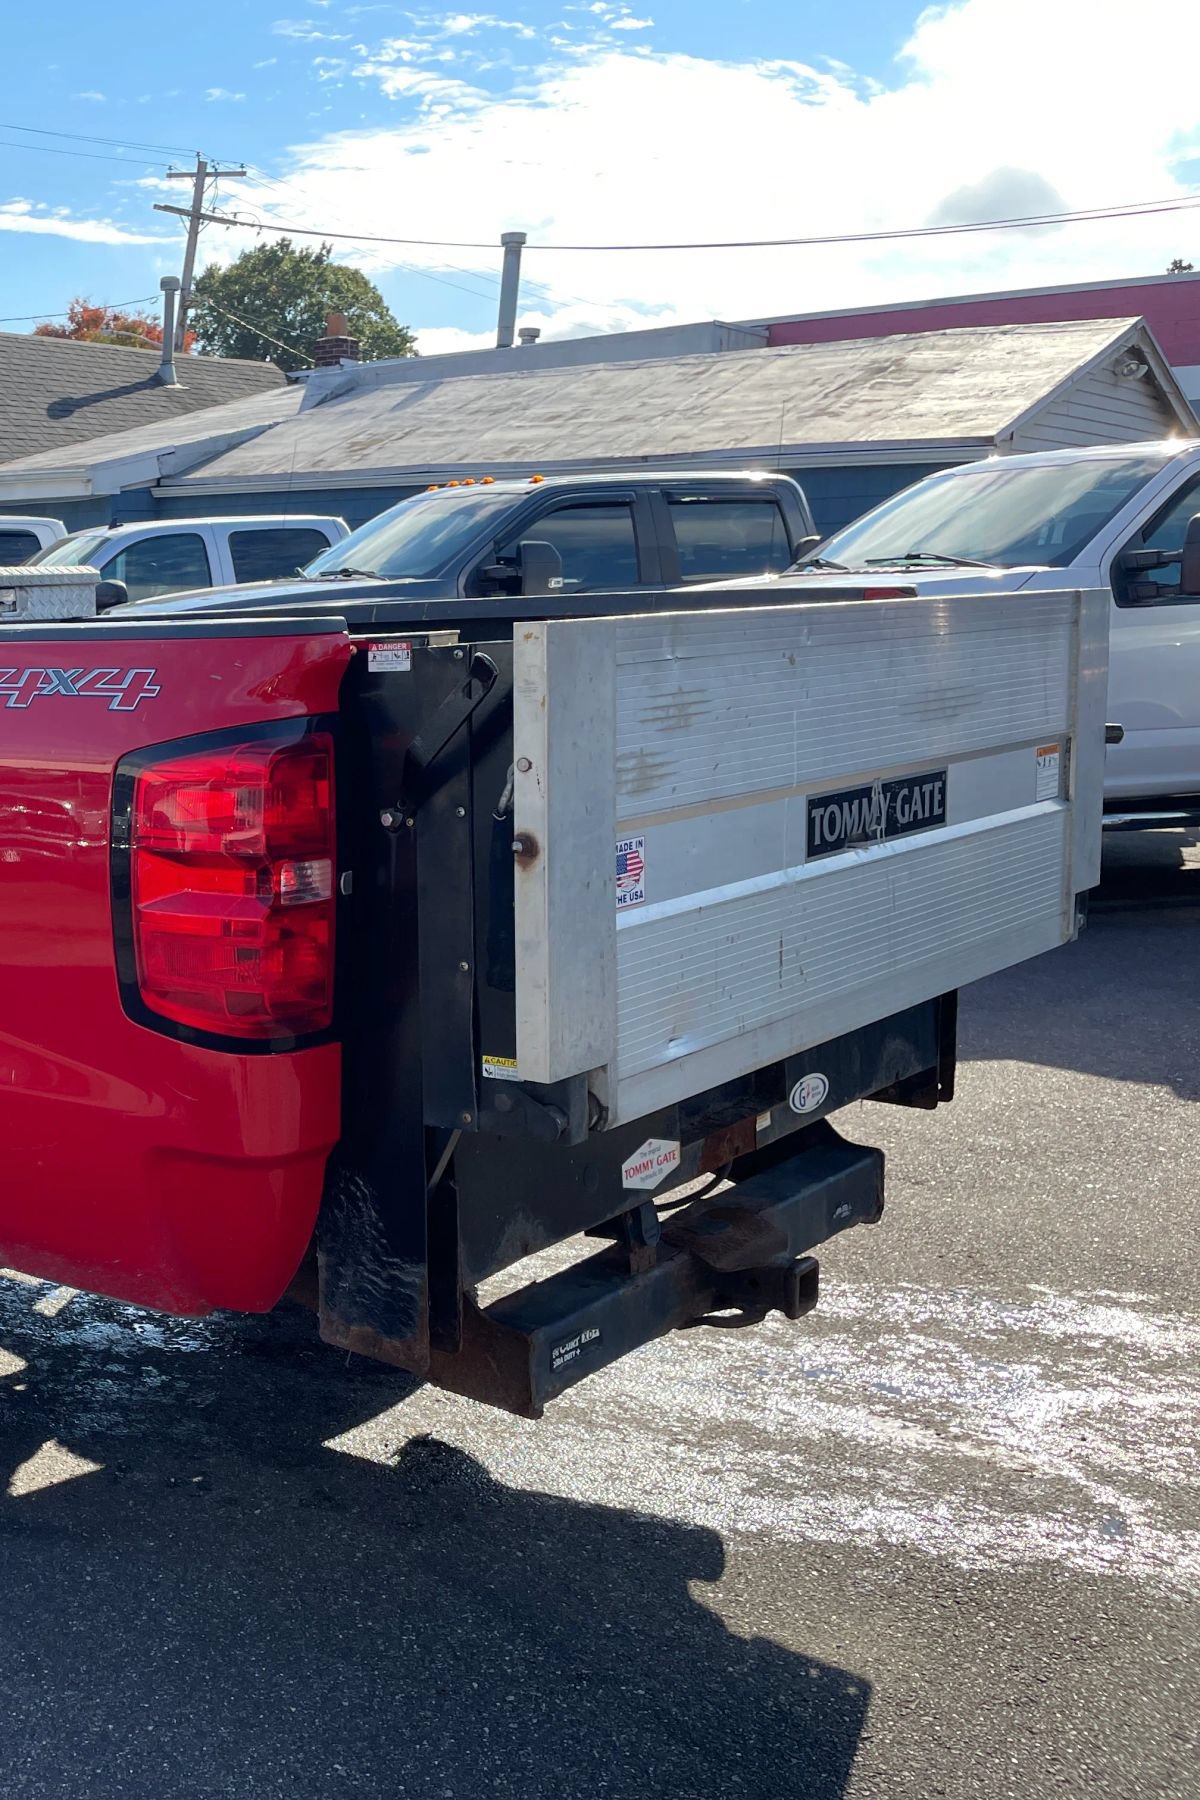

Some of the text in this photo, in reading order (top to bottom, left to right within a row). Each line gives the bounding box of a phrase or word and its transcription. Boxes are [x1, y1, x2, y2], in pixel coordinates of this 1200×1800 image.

[378, 642, 408, 650] DANGER
[811, 780, 945, 846] TOMMY GATE
[636, 839, 643, 848] IN
[616, 890, 644, 904] HE USA
[490, 1057, 518, 1067] CAUTIO
[624, 1149, 677, 1181] TOMMY GATE
